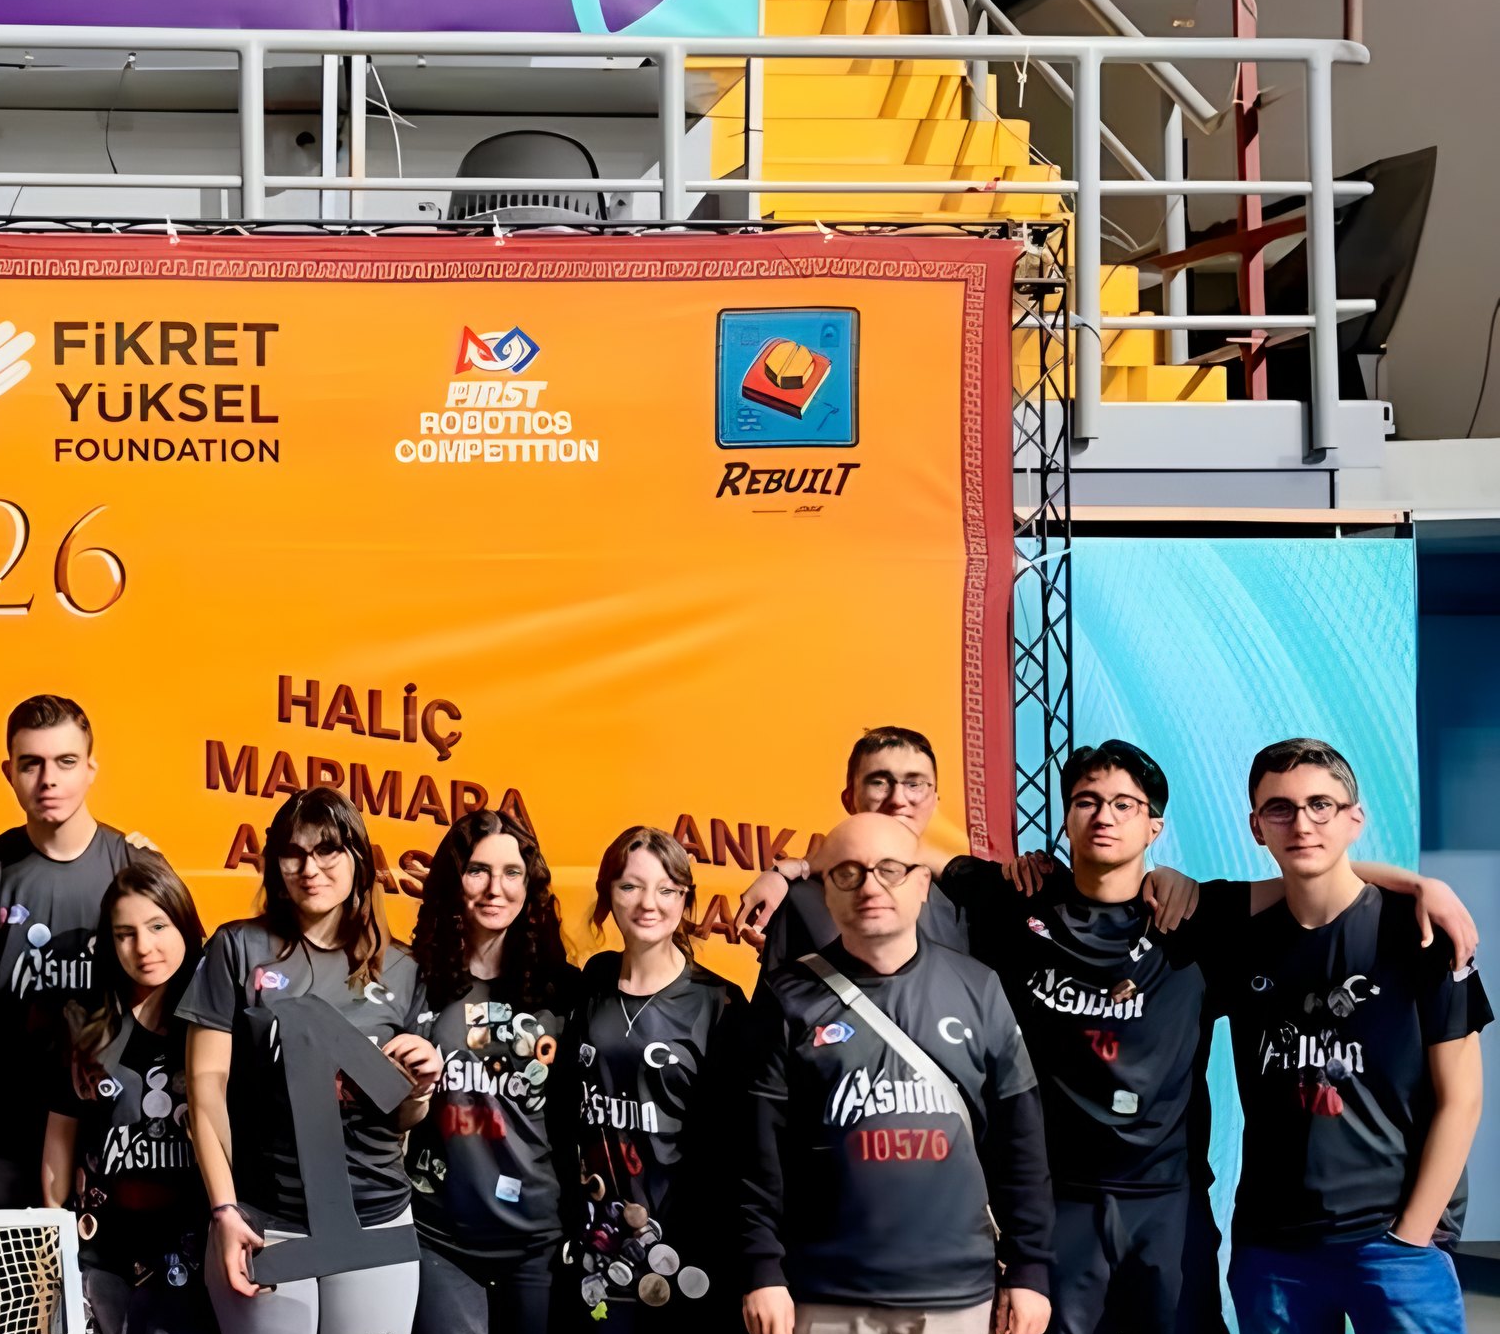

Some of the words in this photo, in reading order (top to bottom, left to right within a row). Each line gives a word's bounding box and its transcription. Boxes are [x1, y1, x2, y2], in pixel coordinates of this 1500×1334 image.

[55, 382, 279, 424] YÜKSEL
[420, 411, 572, 435] ROBOTICS
[55, 438, 279, 463] FOUNDATION
[395, 439, 599, 463] COMPETITION
[277, 674, 463, 762] HALİÇ
